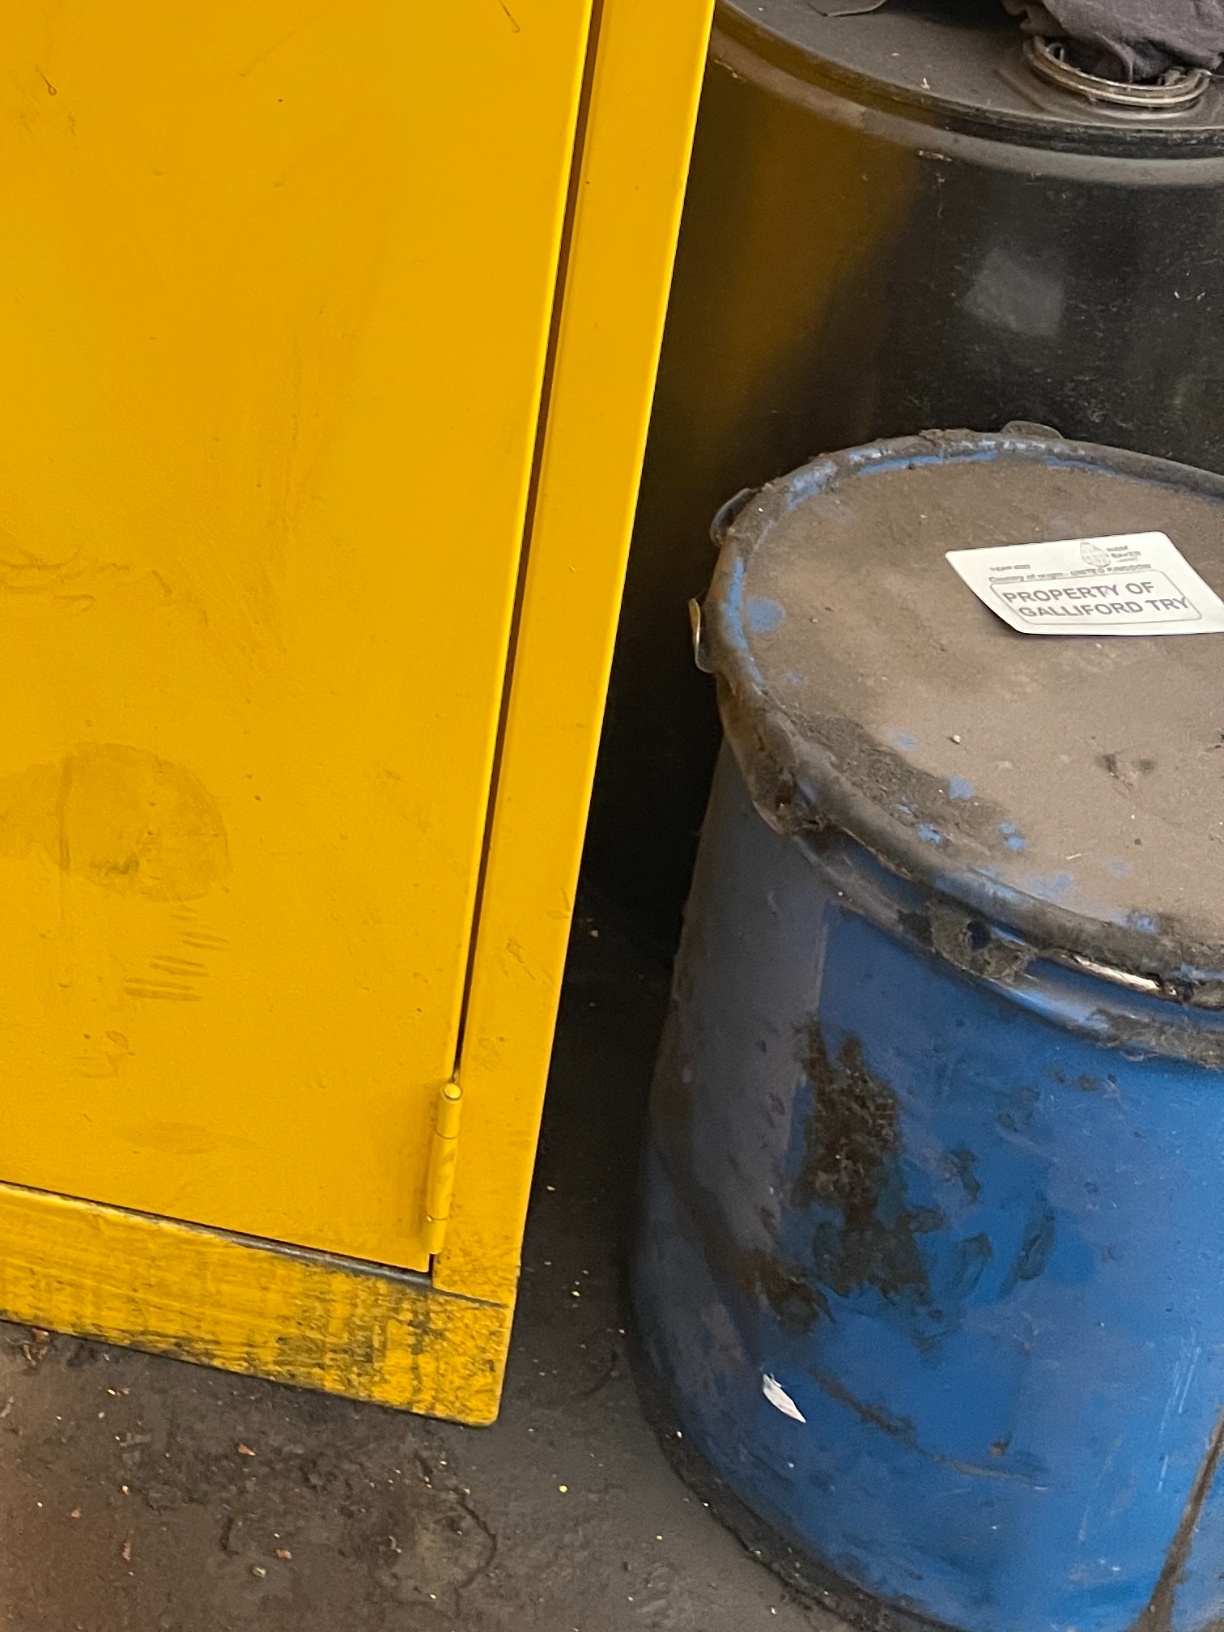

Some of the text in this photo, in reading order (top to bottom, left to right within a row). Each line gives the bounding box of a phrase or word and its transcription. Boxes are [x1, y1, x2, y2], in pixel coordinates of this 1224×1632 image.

[1003, 581, 1155, 603] PROPERTY OF
[1019, 596, 1189, 618] GALLIFORD TRY
